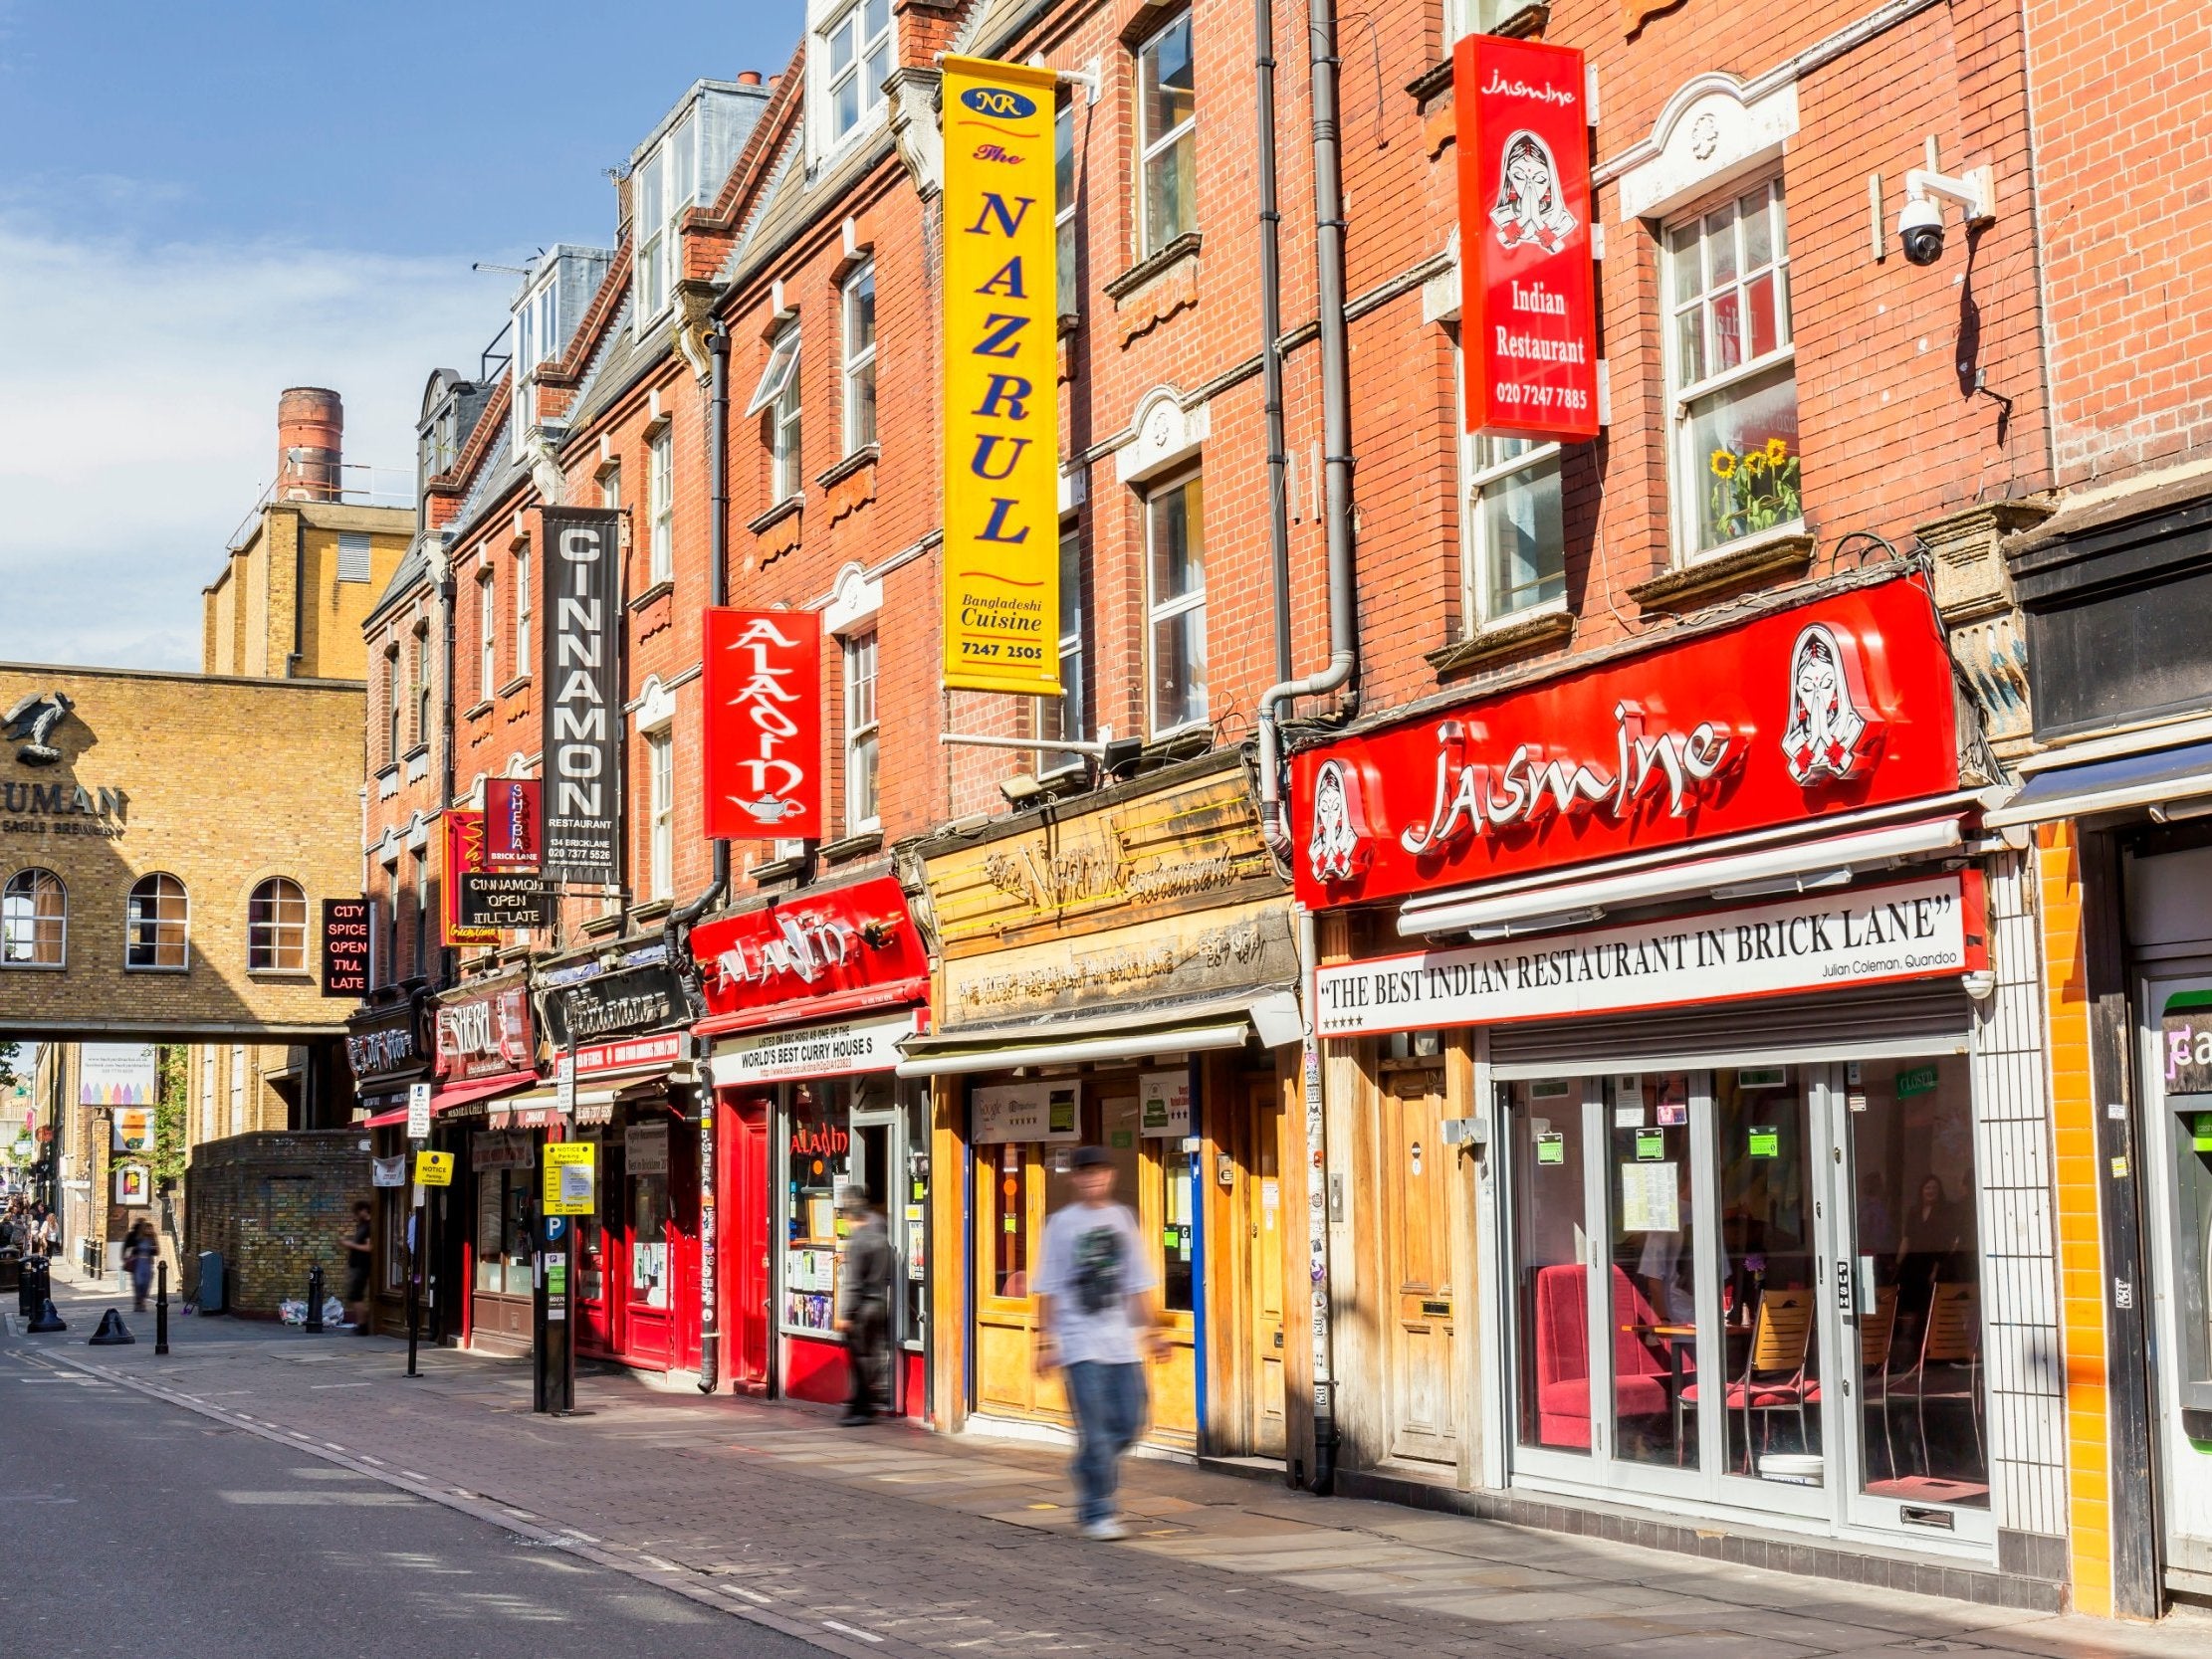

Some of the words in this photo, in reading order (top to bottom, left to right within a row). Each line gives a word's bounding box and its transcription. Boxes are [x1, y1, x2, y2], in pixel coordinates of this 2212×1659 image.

[976, 91, 1022, 116] NR
[973, 143, 1025, 165] The
[1511, 280, 1566, 316] Indian
[1495, 325, 1586, 364] Restaurant
[964, 191, 1036, 544] NAZRUL
[1496, 381, 1521, 404] 020
[1522, 384, 1553, 407] 7247
[1556, 386, 1587, 410] 7885
[962, 594, 1042, 612] Bangladeshi
[961, 607, 1042, 632] Cuisine
[962, 642, 999, 657] 7247
[1007, 645, 1042, 660] 2505
[553, 527, 606, 816] CINNAMON
[2, 820, 47, 834] EAGLE
[512, 783, 524, 850] SHEBA
[549, 819, 612, 829] RESTAURANT
[491, 852, 515, 861] BRICK
[548, 848, 564, 857] 020
[567, 849, 587, 859] 7377
[589, 850, 610, 860] 5526
[470, 878, 544, 891] CINNAMON
[333, 906, 365, 918] CITY
[487, 896, 527, 907] OPEN
[507, 910, 541, 923] LATE
[329, 924, 367, 935] SPICE
[330, 941, 367, 953] OPEN
[333, 959, 362, 971] TILL
[1374, 969, 1424, 1005] BEST
[1428, 957, 1510, 1000] INDIAN
[1517, 933, 1688, 990] RESTAURANT
[1695, 927, 1727, 968] IN
[1734, 912, 1835, 963] BRICK
[1822, 957, 1851, 977] Julian
[1853, 956, 1902, 974] Coleman,
[1904, 950, 1957, 968] Quandoo
[331, 977, 364, 989] LATE
[451, 1000, 491, 1066] SHEBA
[758, 1036, 775, 1048] LISTED
[776, 1035, 783, 1046] ON
[783, 1033, 795, 1044] BBC
[817, 1028, 829, 1040] ONE
[830, 1026, 837, 1038] OF
[839, 1025, 850, 1037] THE
[742, 1048, 775, 1069] WORLD'S
[777, 1046, 798, 1064] BEST
[800, 1042, 830, 1062] CURRY
[833, 1038, 864, 1057] HOUSE
[1900, 1071, 1933, 1093] CLOSED
[549, 1217, 561, 1236] P
[1839, 1264, 1849, 1307] PUSH
